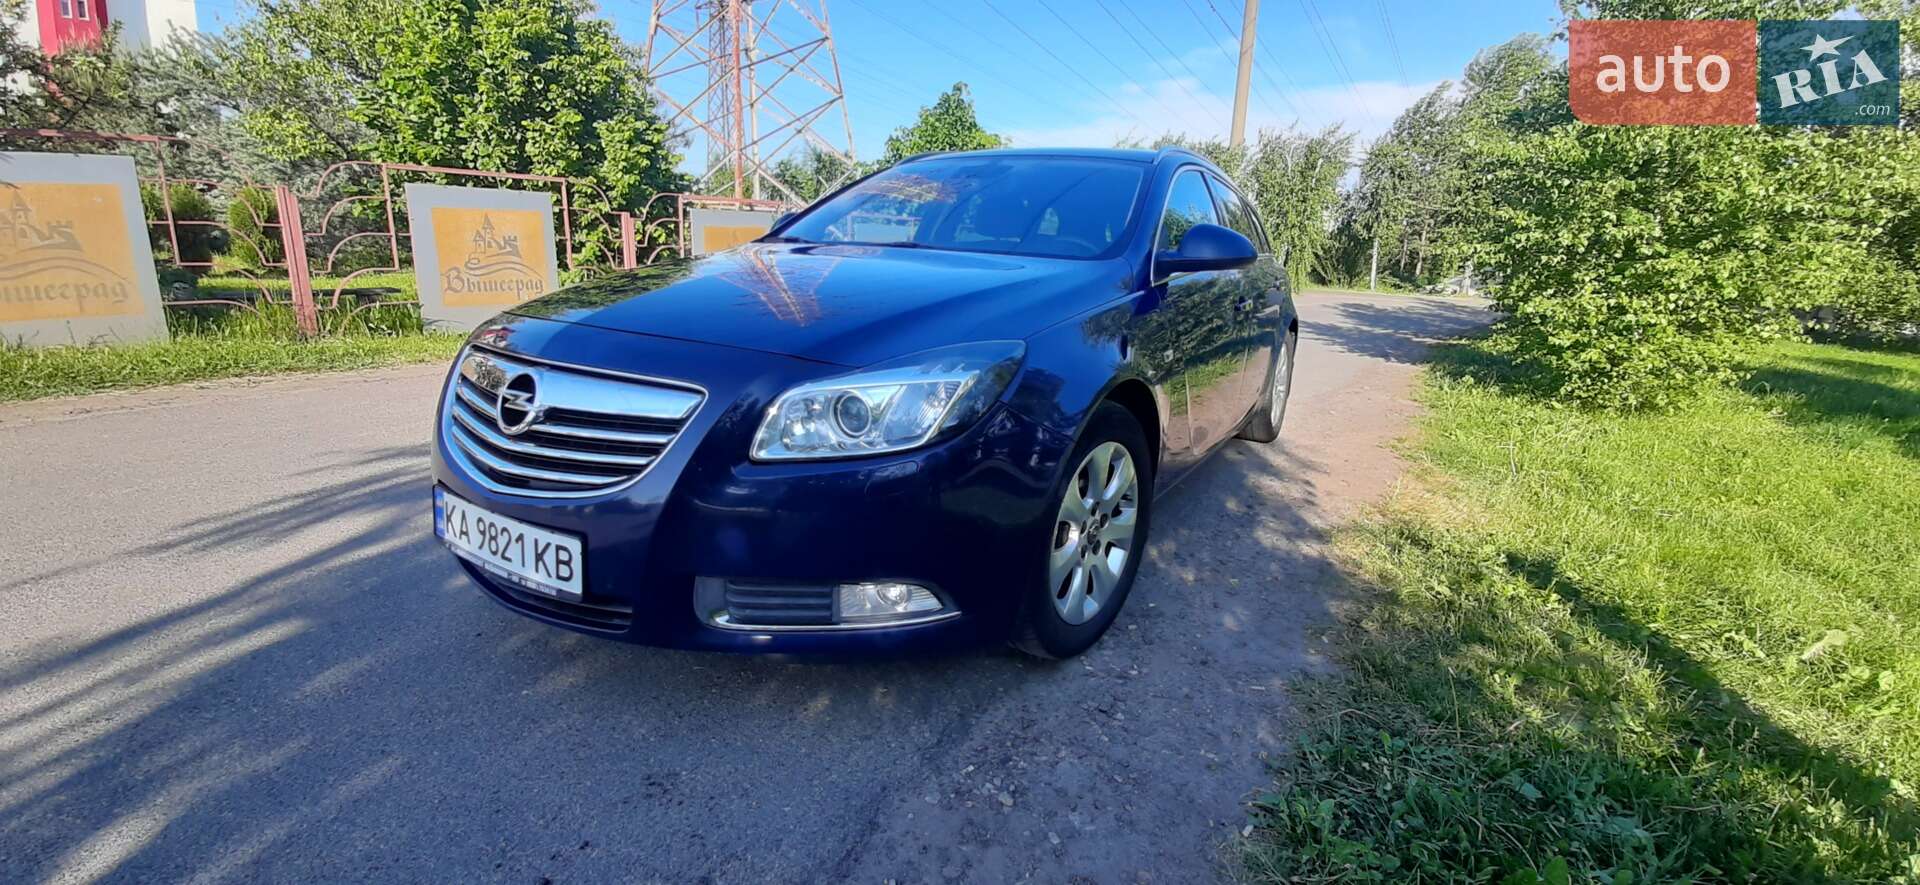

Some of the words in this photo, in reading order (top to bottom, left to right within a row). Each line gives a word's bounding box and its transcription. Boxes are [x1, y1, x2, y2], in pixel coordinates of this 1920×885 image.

[445, 501, 471, 544] KA
[476, 516, 526, 568] 9821
[534, 538, 574, 582] KB
